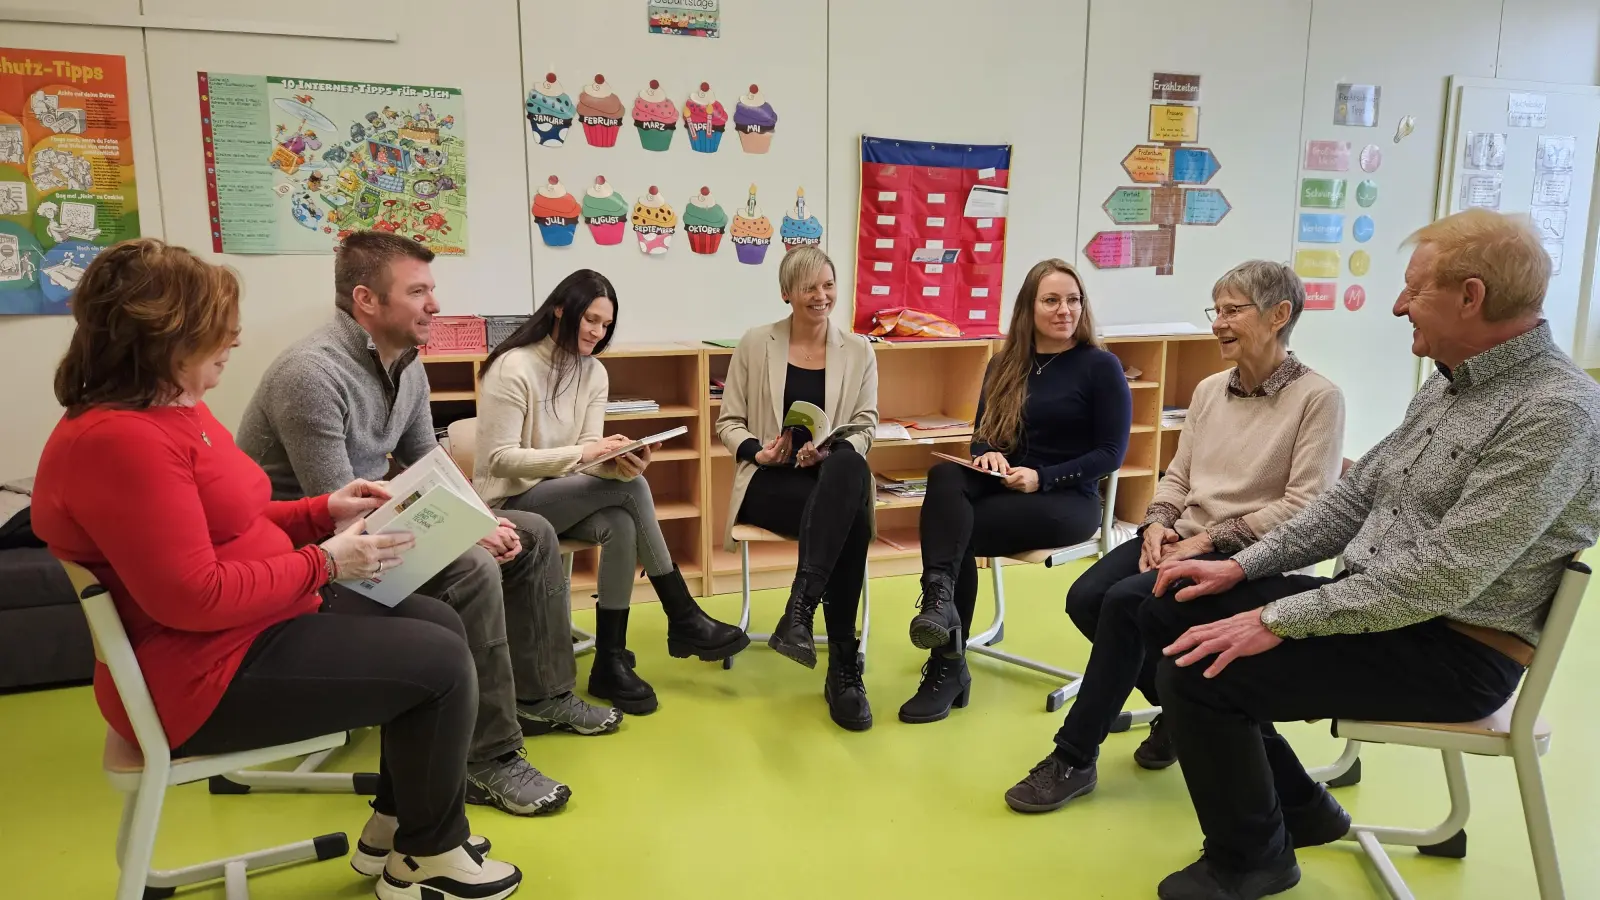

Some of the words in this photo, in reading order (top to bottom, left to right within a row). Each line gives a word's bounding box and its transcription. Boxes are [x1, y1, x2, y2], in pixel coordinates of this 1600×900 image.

[281, 79, 296, 90] 10
[533, 114, 564, 125] JANUAR
[584, 116, 618, 126] FEBRUAR
[747, 125, 761, 133] MAI
[545, 217, 565, 226] JULI
[590, 216, 619, 225] AUGUST
[634, 225, 674, 234] SEPTEMBER
[688, 225, 720, 234] OKTOBER
[733, 236, 769, 245] NOVEMBER
[1305, 291, 1328, 301] erken
[1347, 289, 1361, 307] M
